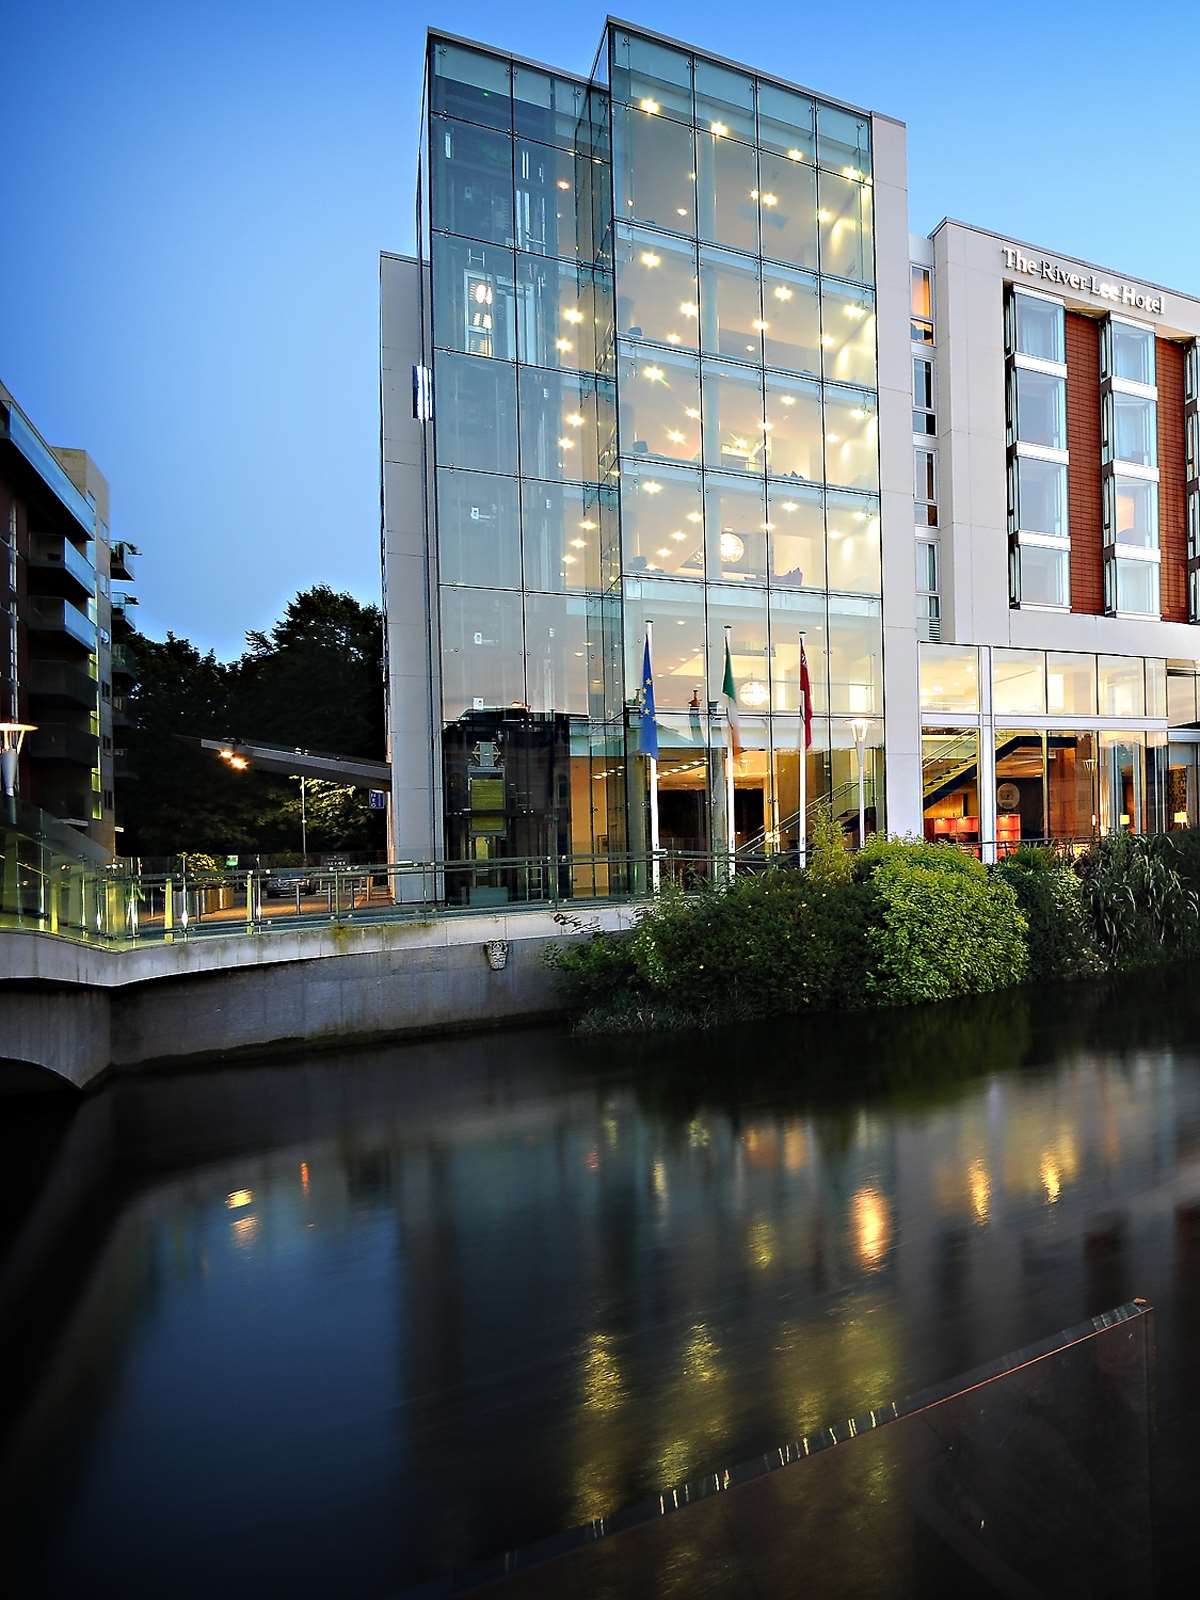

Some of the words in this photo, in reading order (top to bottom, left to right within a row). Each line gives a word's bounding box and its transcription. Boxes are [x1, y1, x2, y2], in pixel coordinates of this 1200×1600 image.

[1002, 246, 1038, 274] The
[1040, 259, 1089, 290] River
[1090, 275, 1120, 302] Lee
[1120, 285, 1165, 315] Hotel
